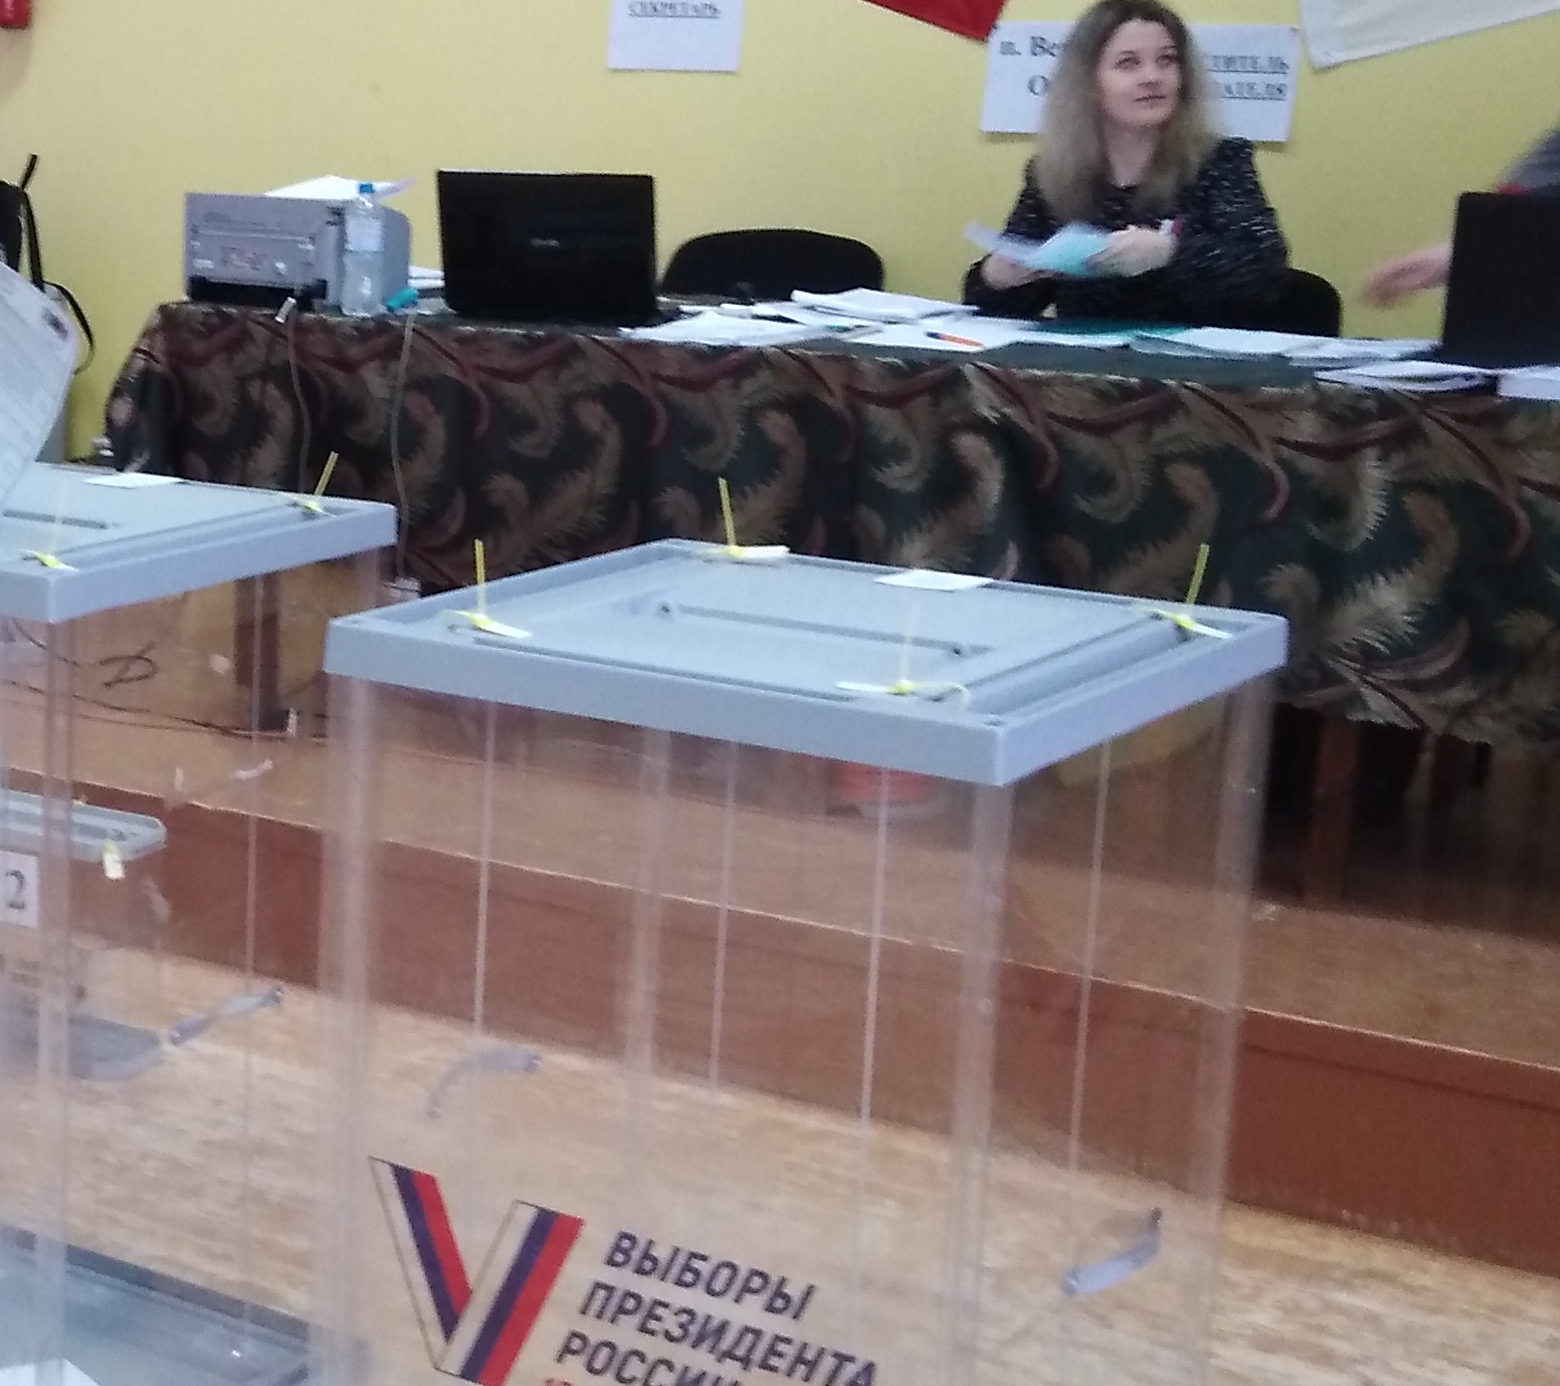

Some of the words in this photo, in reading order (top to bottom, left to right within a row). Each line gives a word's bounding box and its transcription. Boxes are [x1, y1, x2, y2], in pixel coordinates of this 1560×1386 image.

[627, 0, 721, 18] СЕКРЕТАРЬ
[1206, 55, 1290, 74] ТИТЕЛЬ
[4, 869, 27, 911] 2
[604, 1229, 817, 1321] ВЫБОРЫ
